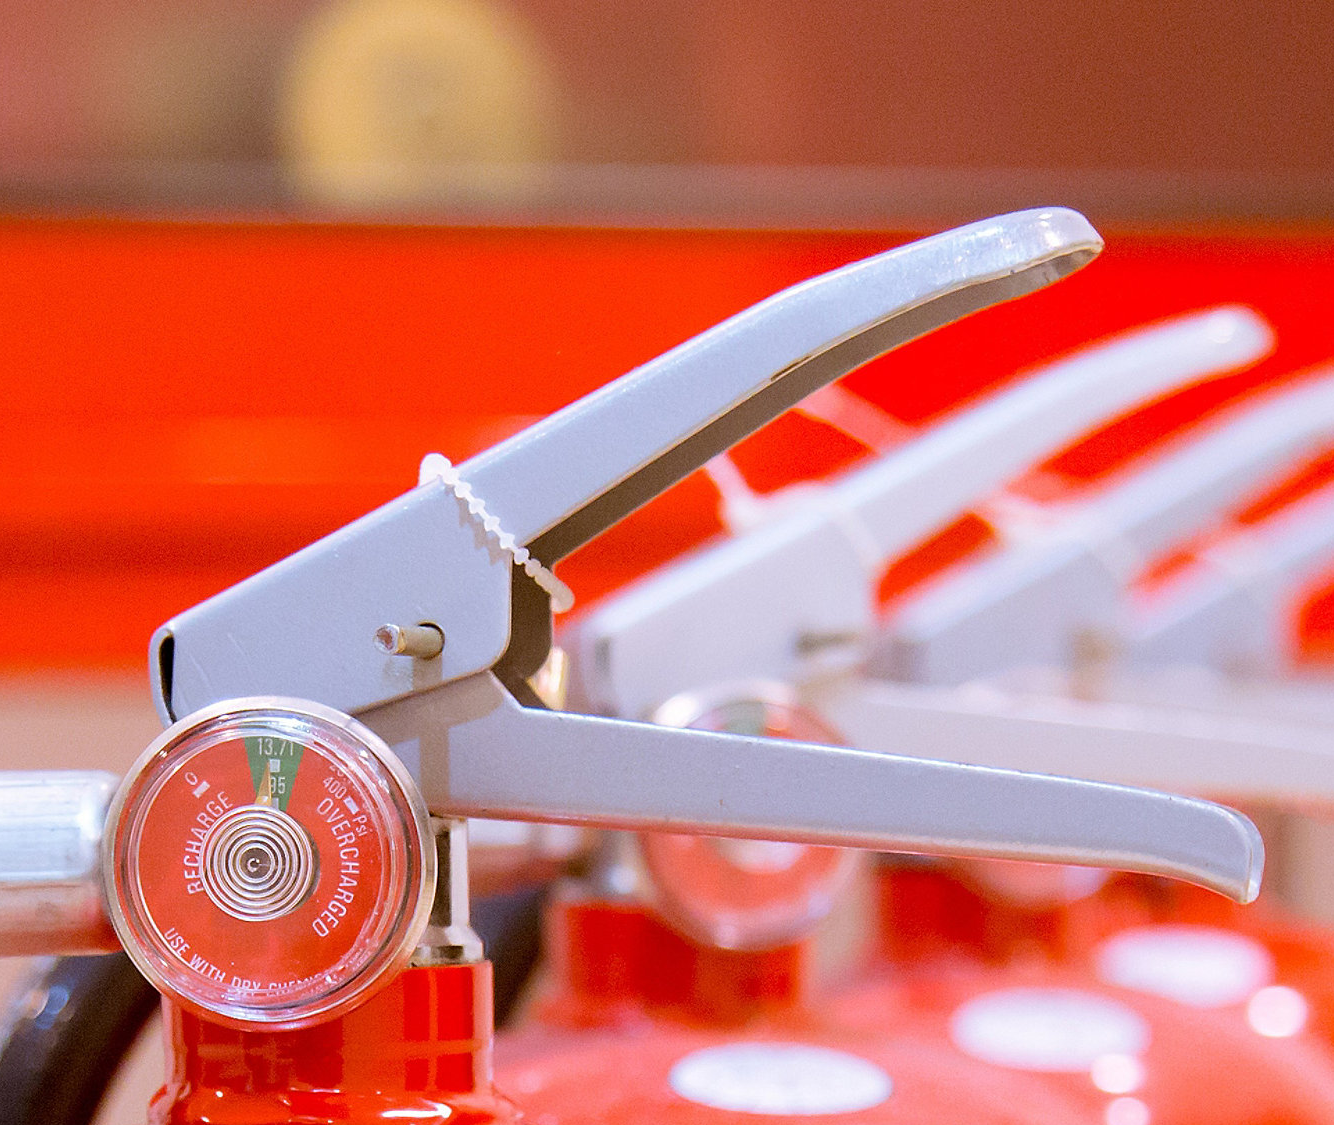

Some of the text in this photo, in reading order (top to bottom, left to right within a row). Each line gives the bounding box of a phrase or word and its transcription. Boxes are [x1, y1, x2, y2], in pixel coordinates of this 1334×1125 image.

[269, 776, 286, 794] 95
[323, 777, 347, 799] 400
[183, 791, 234, 895] RECHARGE
[312, 797, 360, 938] OVERCHARGED
[164, 928, 190, 958] USE
[189, 953, 226, 983] WITH
